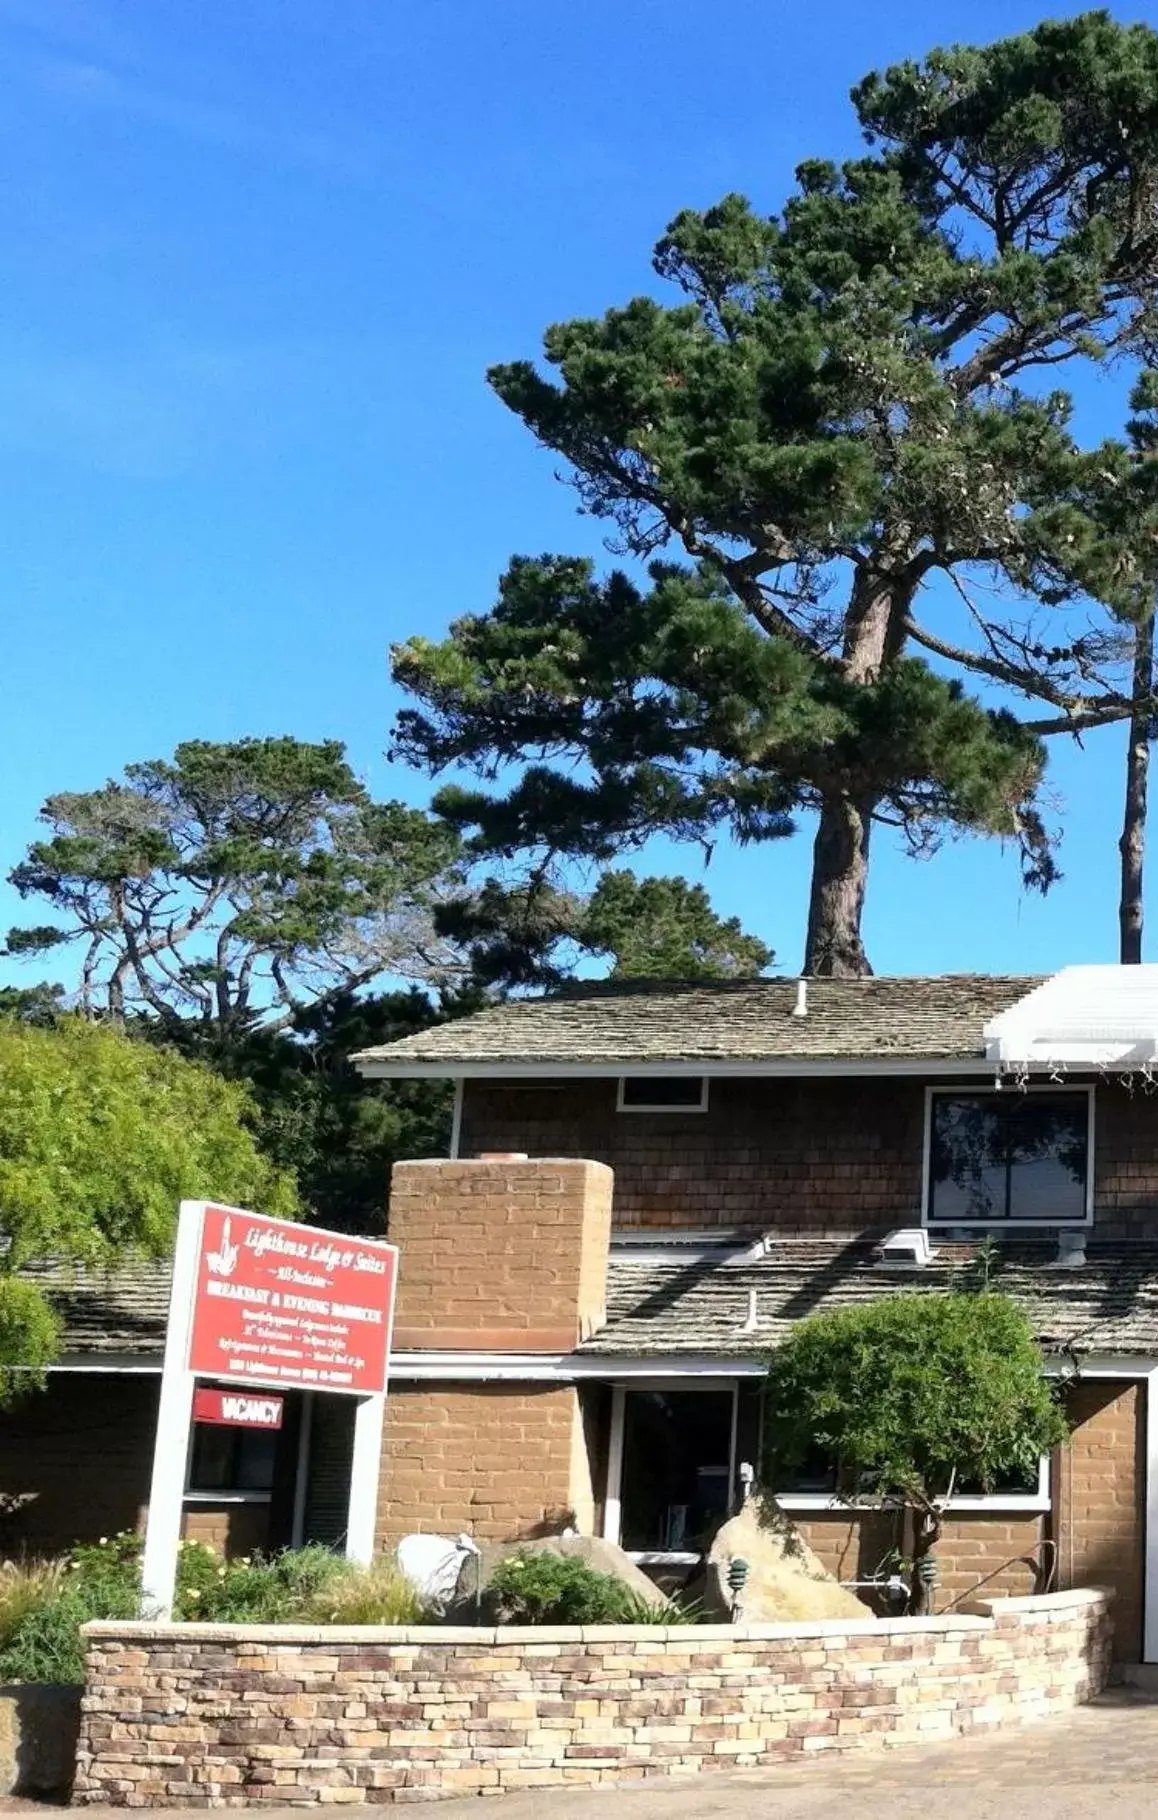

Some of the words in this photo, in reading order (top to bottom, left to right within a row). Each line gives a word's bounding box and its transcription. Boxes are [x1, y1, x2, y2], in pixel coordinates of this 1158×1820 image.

[245, 1228, 309, 1258] Lighthouse
[309, 1241, 342, 1272] Lodge
[355, 1254, 387, 1275] Suites
[222, 1396, 282, 1424] VACANCY
